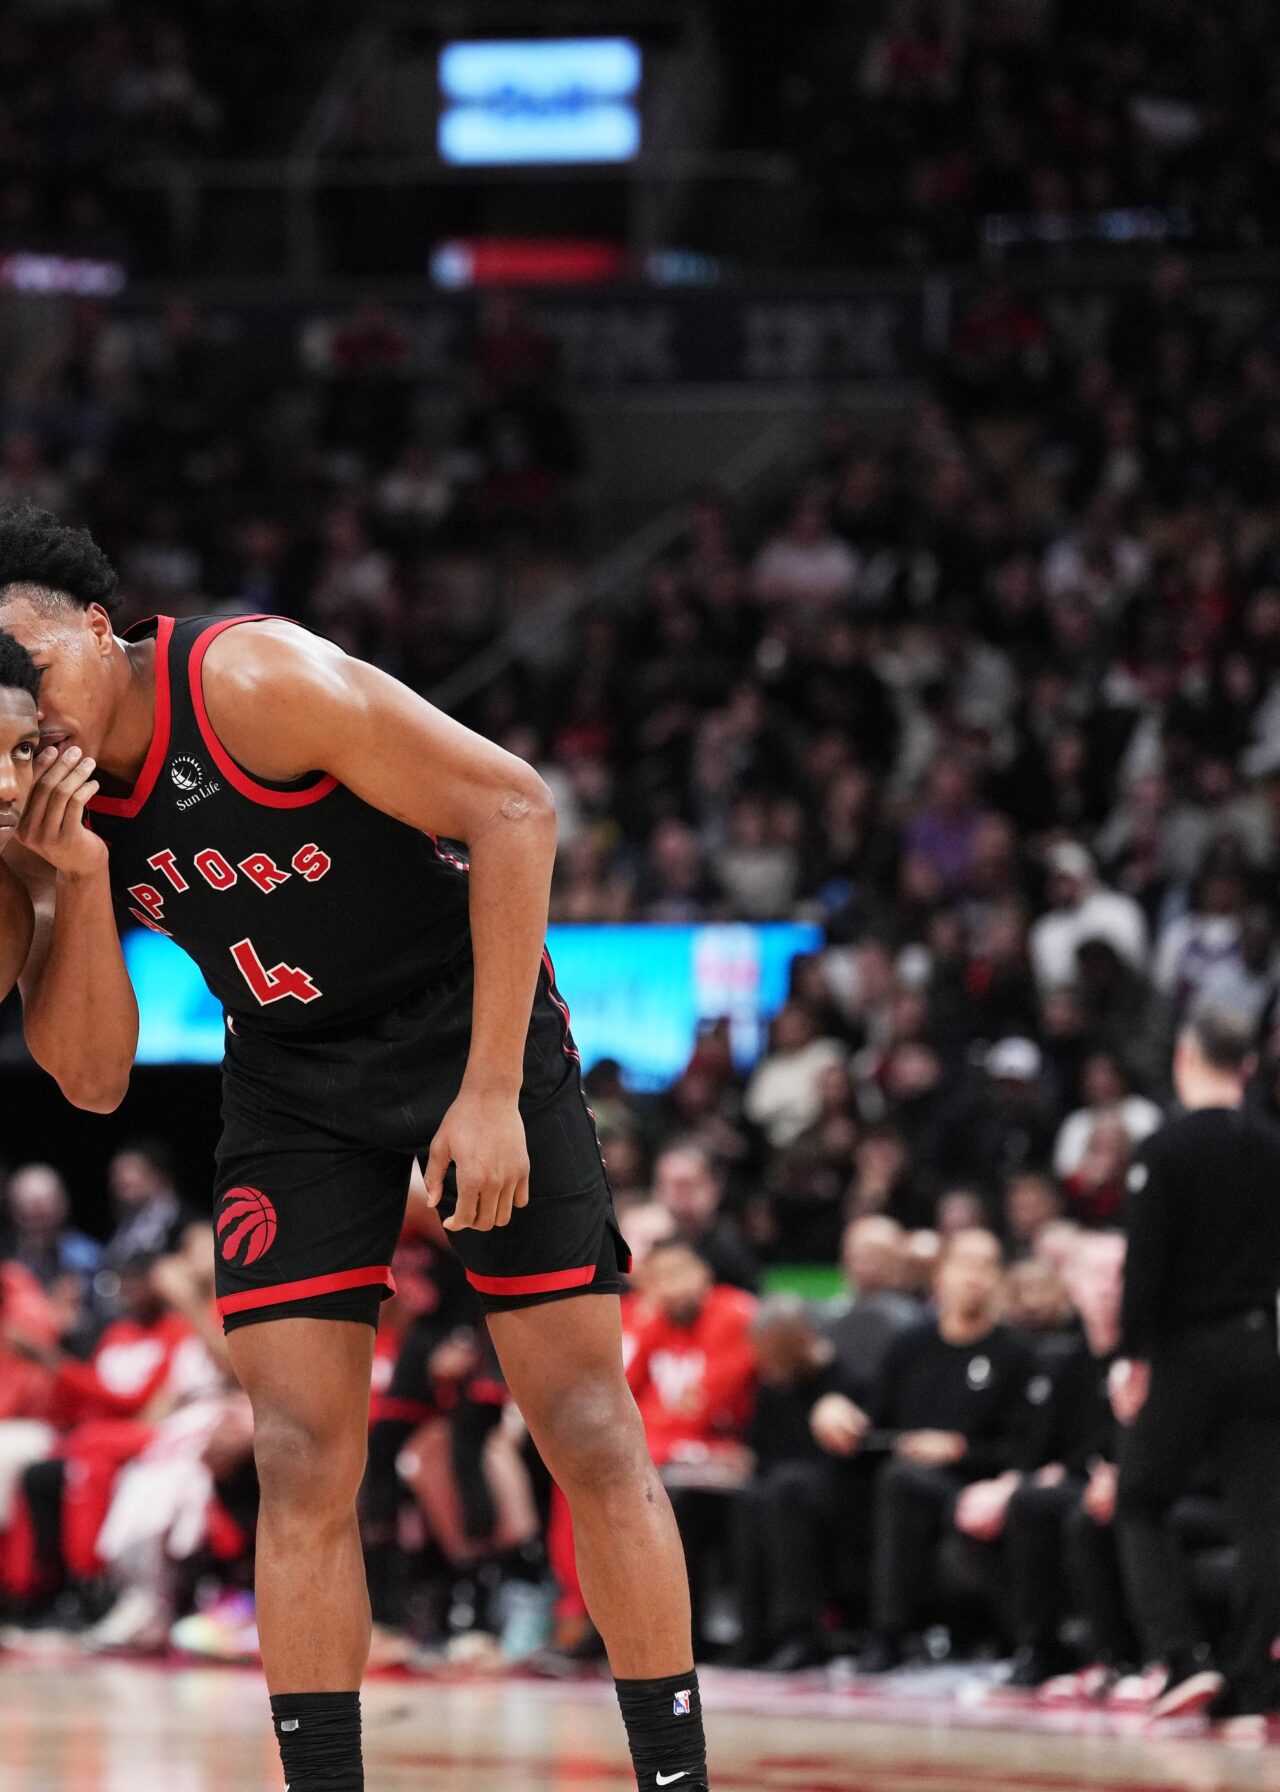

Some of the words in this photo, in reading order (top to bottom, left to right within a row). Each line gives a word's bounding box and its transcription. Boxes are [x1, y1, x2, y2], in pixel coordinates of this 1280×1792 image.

[176, 794, 201, 811] Sun
[199, 781, 221, 798] Life
[127, 842, 332, 936] APTORS
[229, 937, 323, 1006] 4
